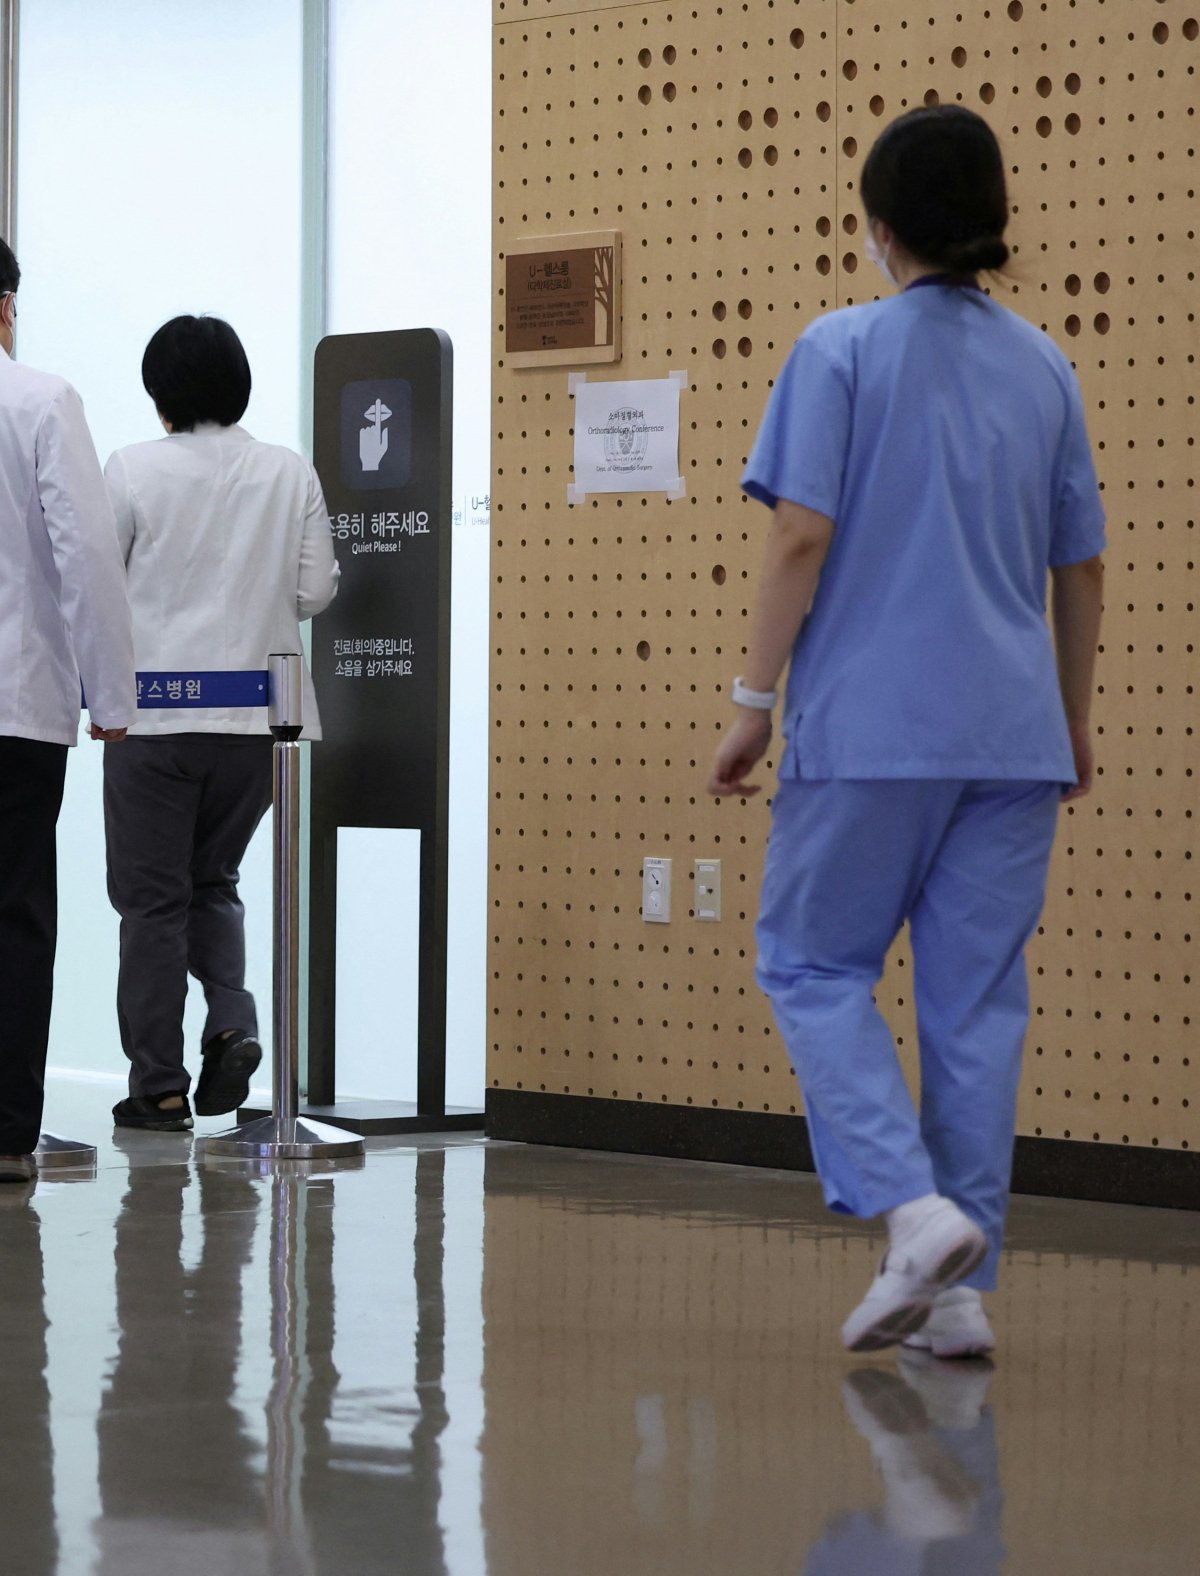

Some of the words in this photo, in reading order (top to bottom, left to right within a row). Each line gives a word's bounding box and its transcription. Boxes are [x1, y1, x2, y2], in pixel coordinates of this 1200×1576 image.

[631, 424, 665, 434] Conference
[371, 510, 430, 538] 해주세요
[351, 542, 373, 555] Quiet
[333, 638, 415, 656] 진료(회의)중입니다.
[334, 659, 363, 677] 소음을
[365, 659, 413, 677] 삼가주세요
